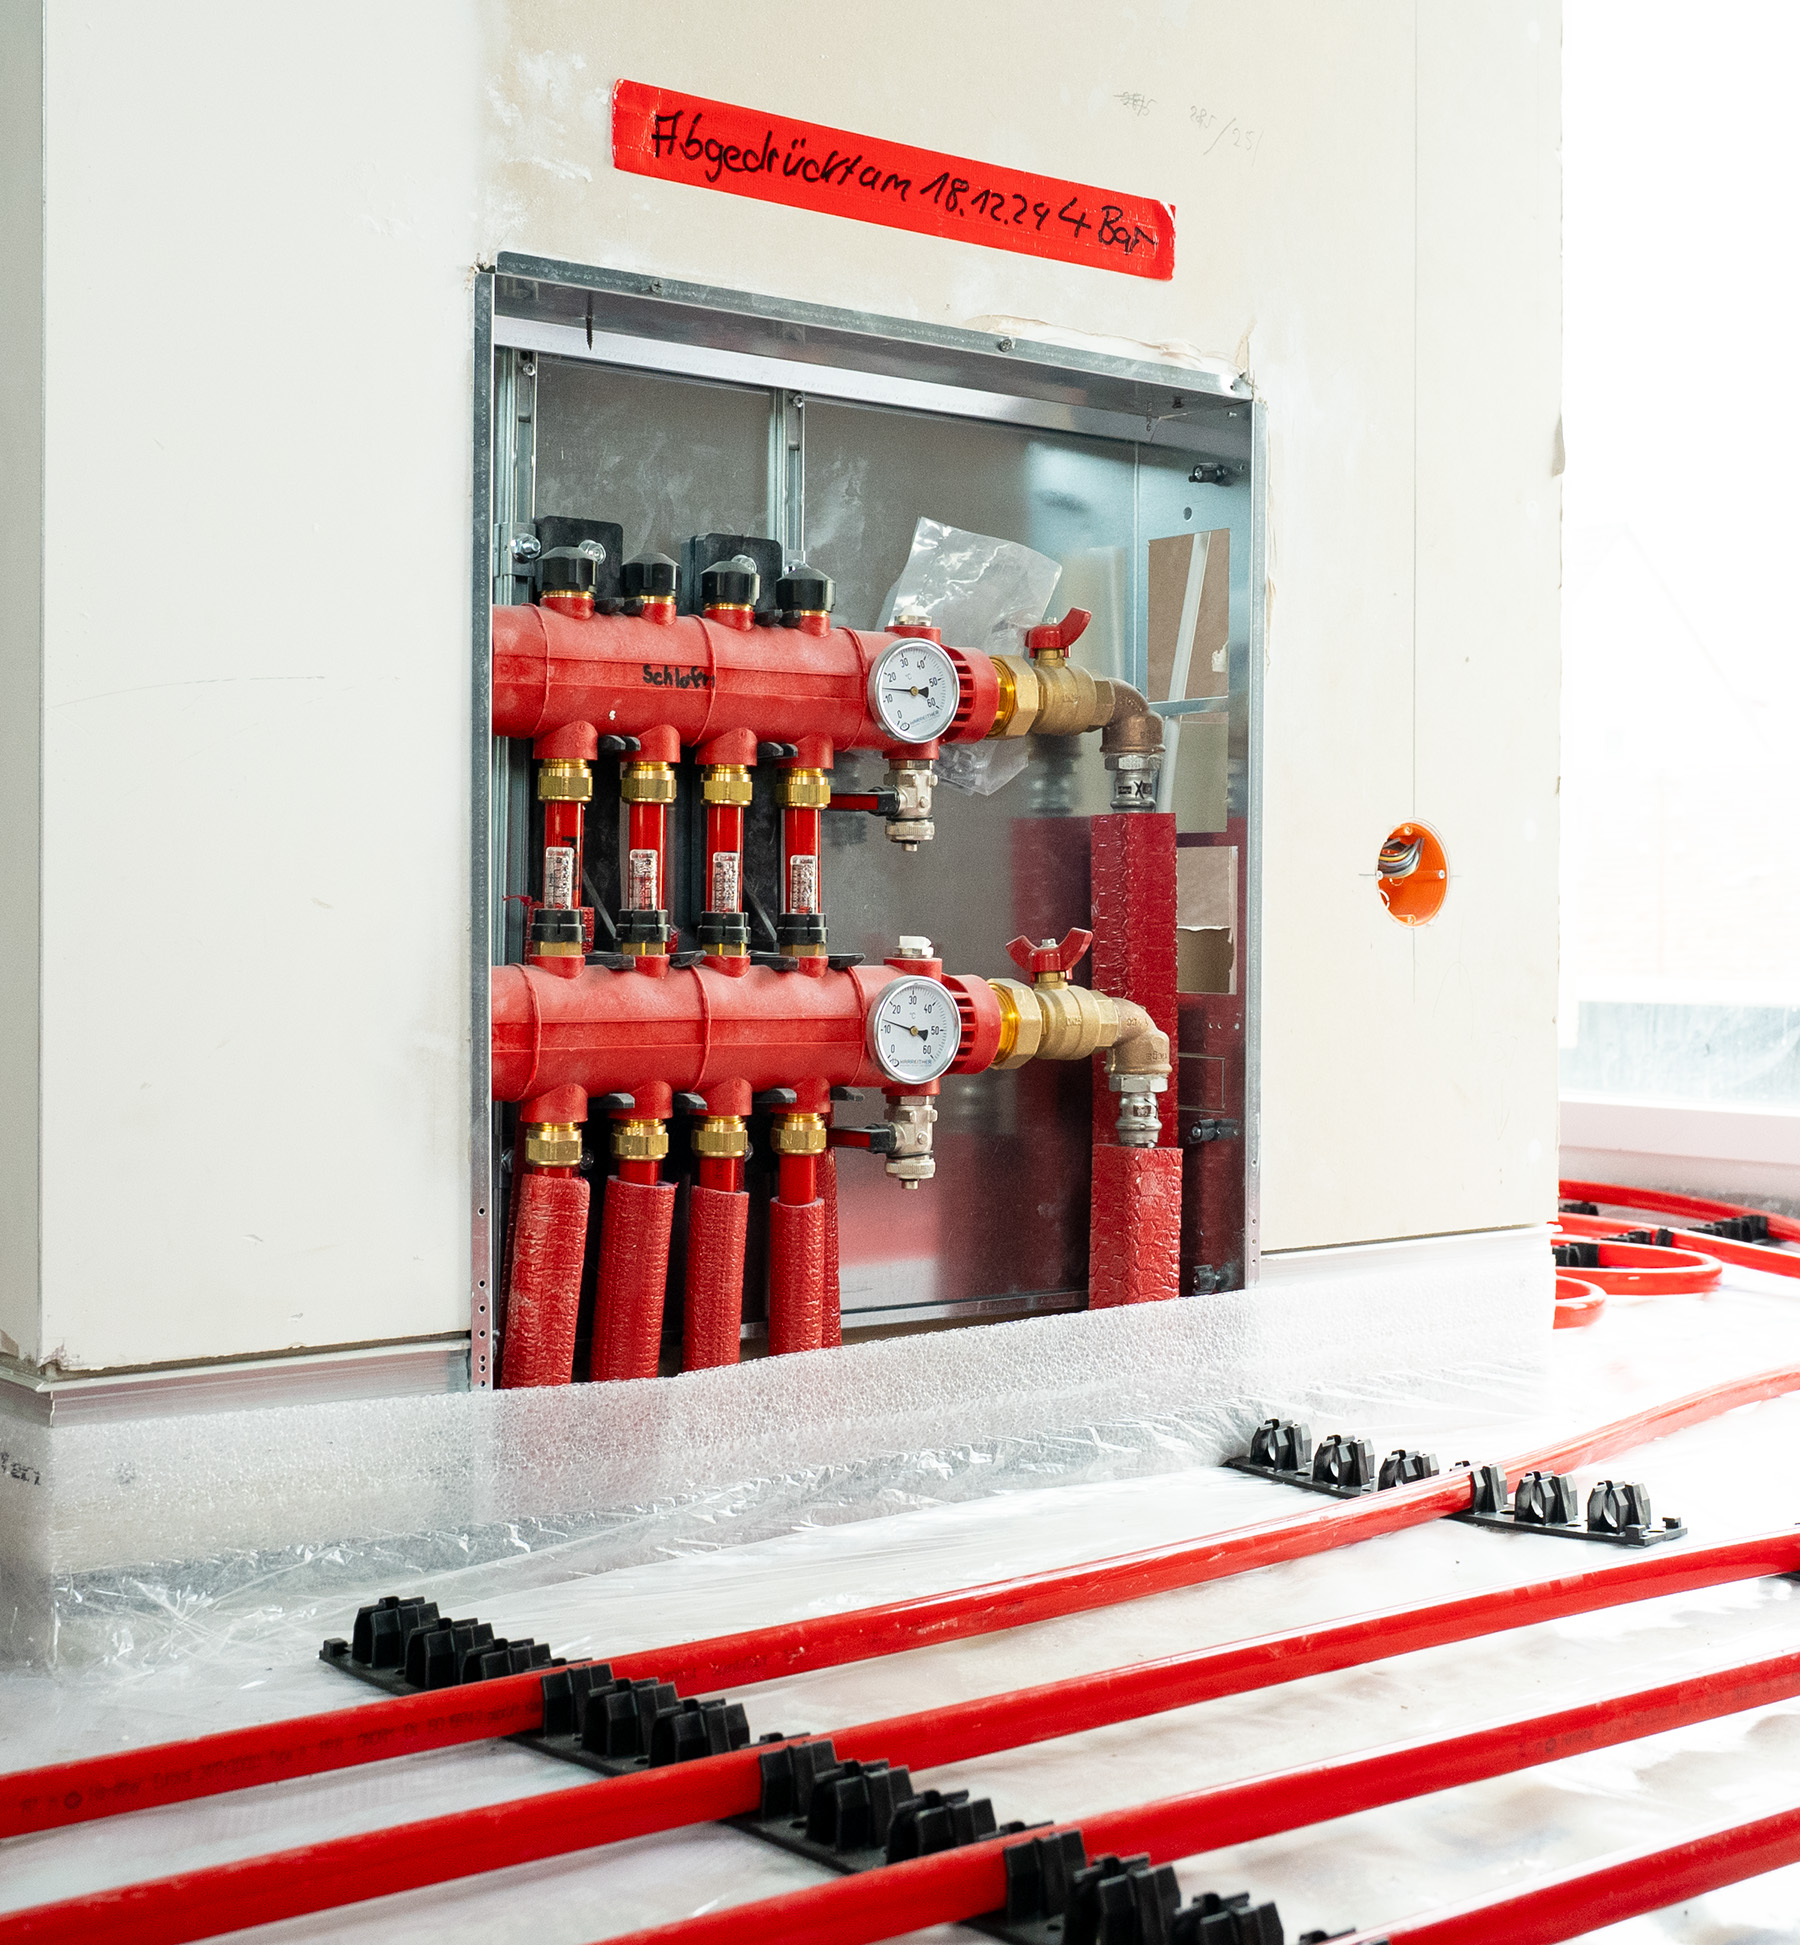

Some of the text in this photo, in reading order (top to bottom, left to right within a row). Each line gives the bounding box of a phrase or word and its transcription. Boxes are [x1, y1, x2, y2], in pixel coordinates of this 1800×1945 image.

[920, 172, 1051, 231] 18.12.24
[1058, 196, 1093, 239] 4
[1098, 204, 1160, 256] Bar
[899, 657, 909, 668] 30
[916, 660, 925, 670] 40
[887, 672, 896, 682] 20
[929, 677, 938, 687] 50
[927, 697, 935, 707] 60
[897, 710, 902, 719] 0
[908, 995, 917, 1005] 30
[892, 1004, 901, 1014] 20
[923, 1004, 932, 1014] 40
[931, 1025, 939, 1035] 50
[890, 1044, 895, 1053] 0
[922, 1044, 932, 1054] 60
